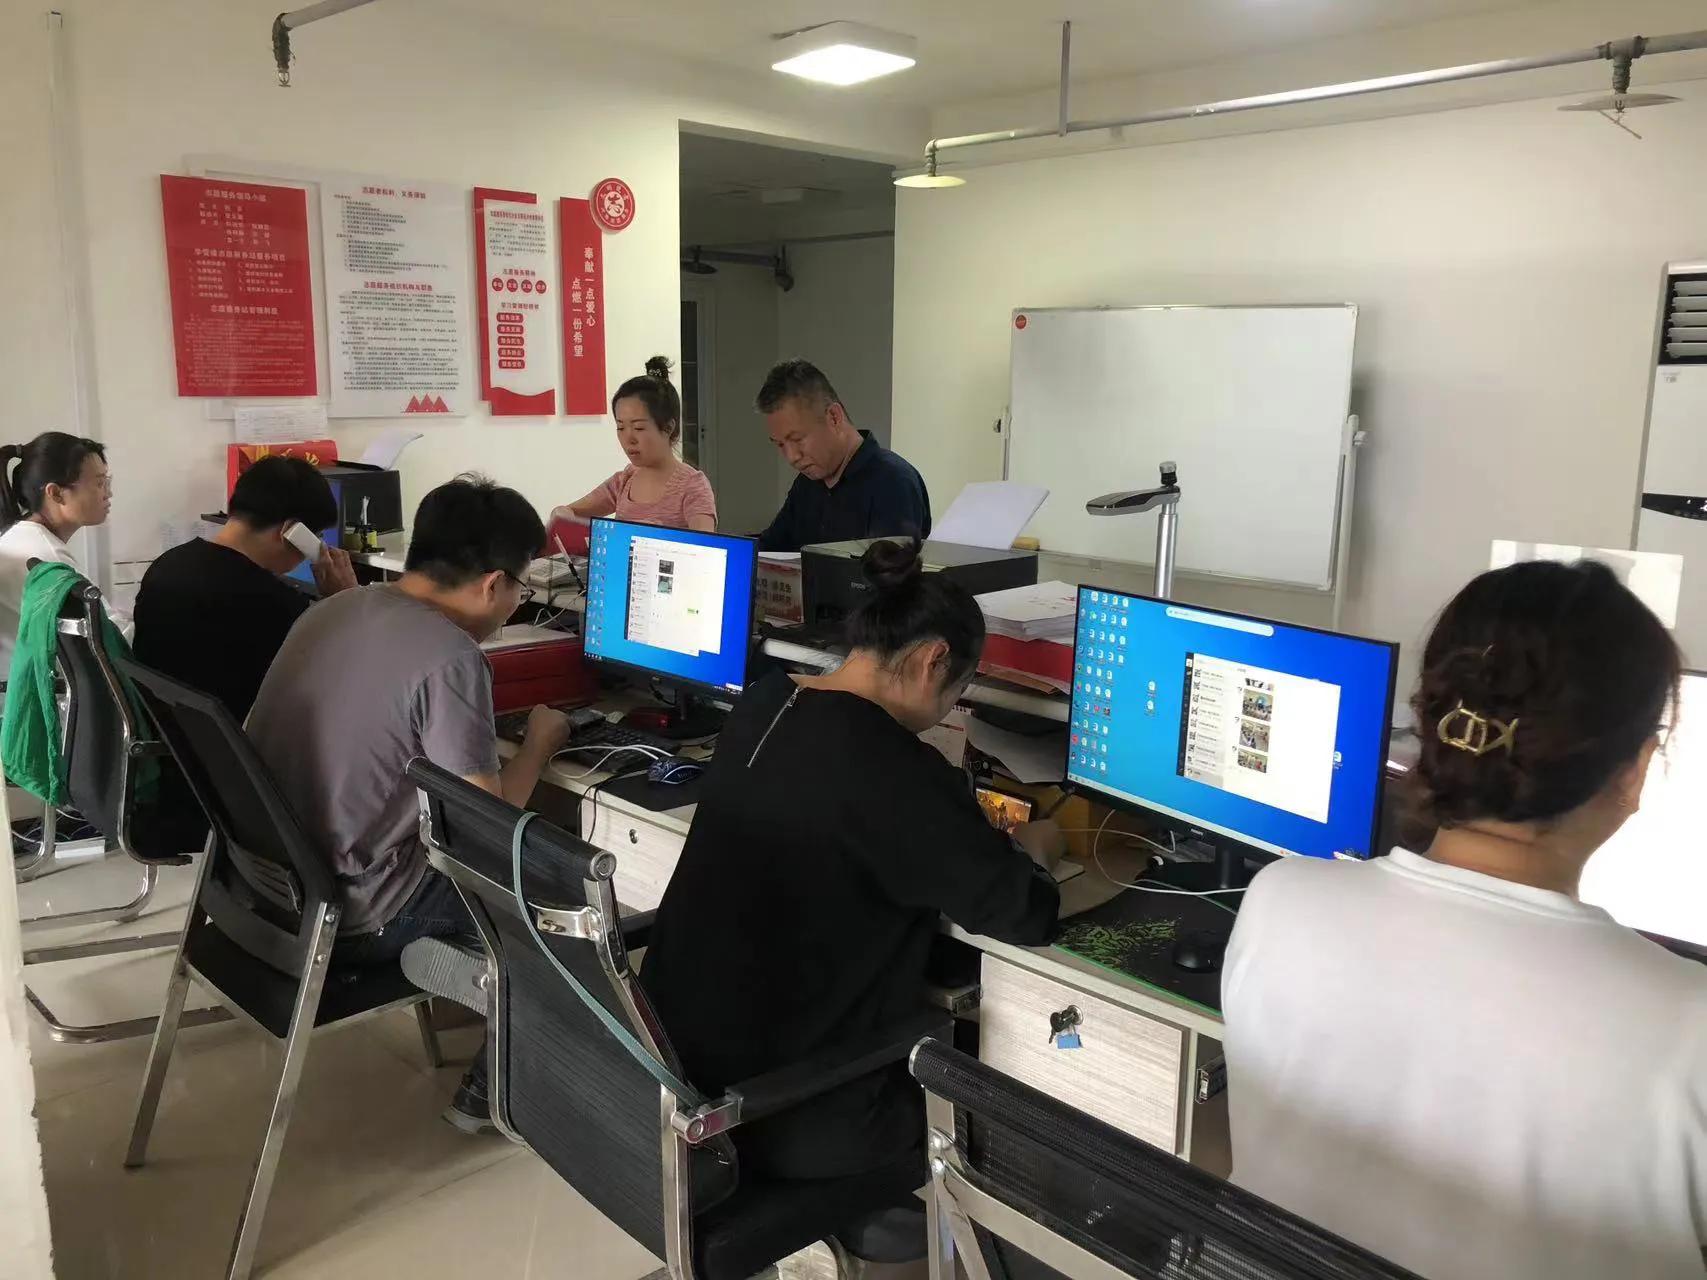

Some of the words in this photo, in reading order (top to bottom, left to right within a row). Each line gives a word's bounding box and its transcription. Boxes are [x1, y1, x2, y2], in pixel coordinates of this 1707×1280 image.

[572, 278, 584, 357] 点燃一份希望
[584, 247, 596, 327] 奉献一点爱心
